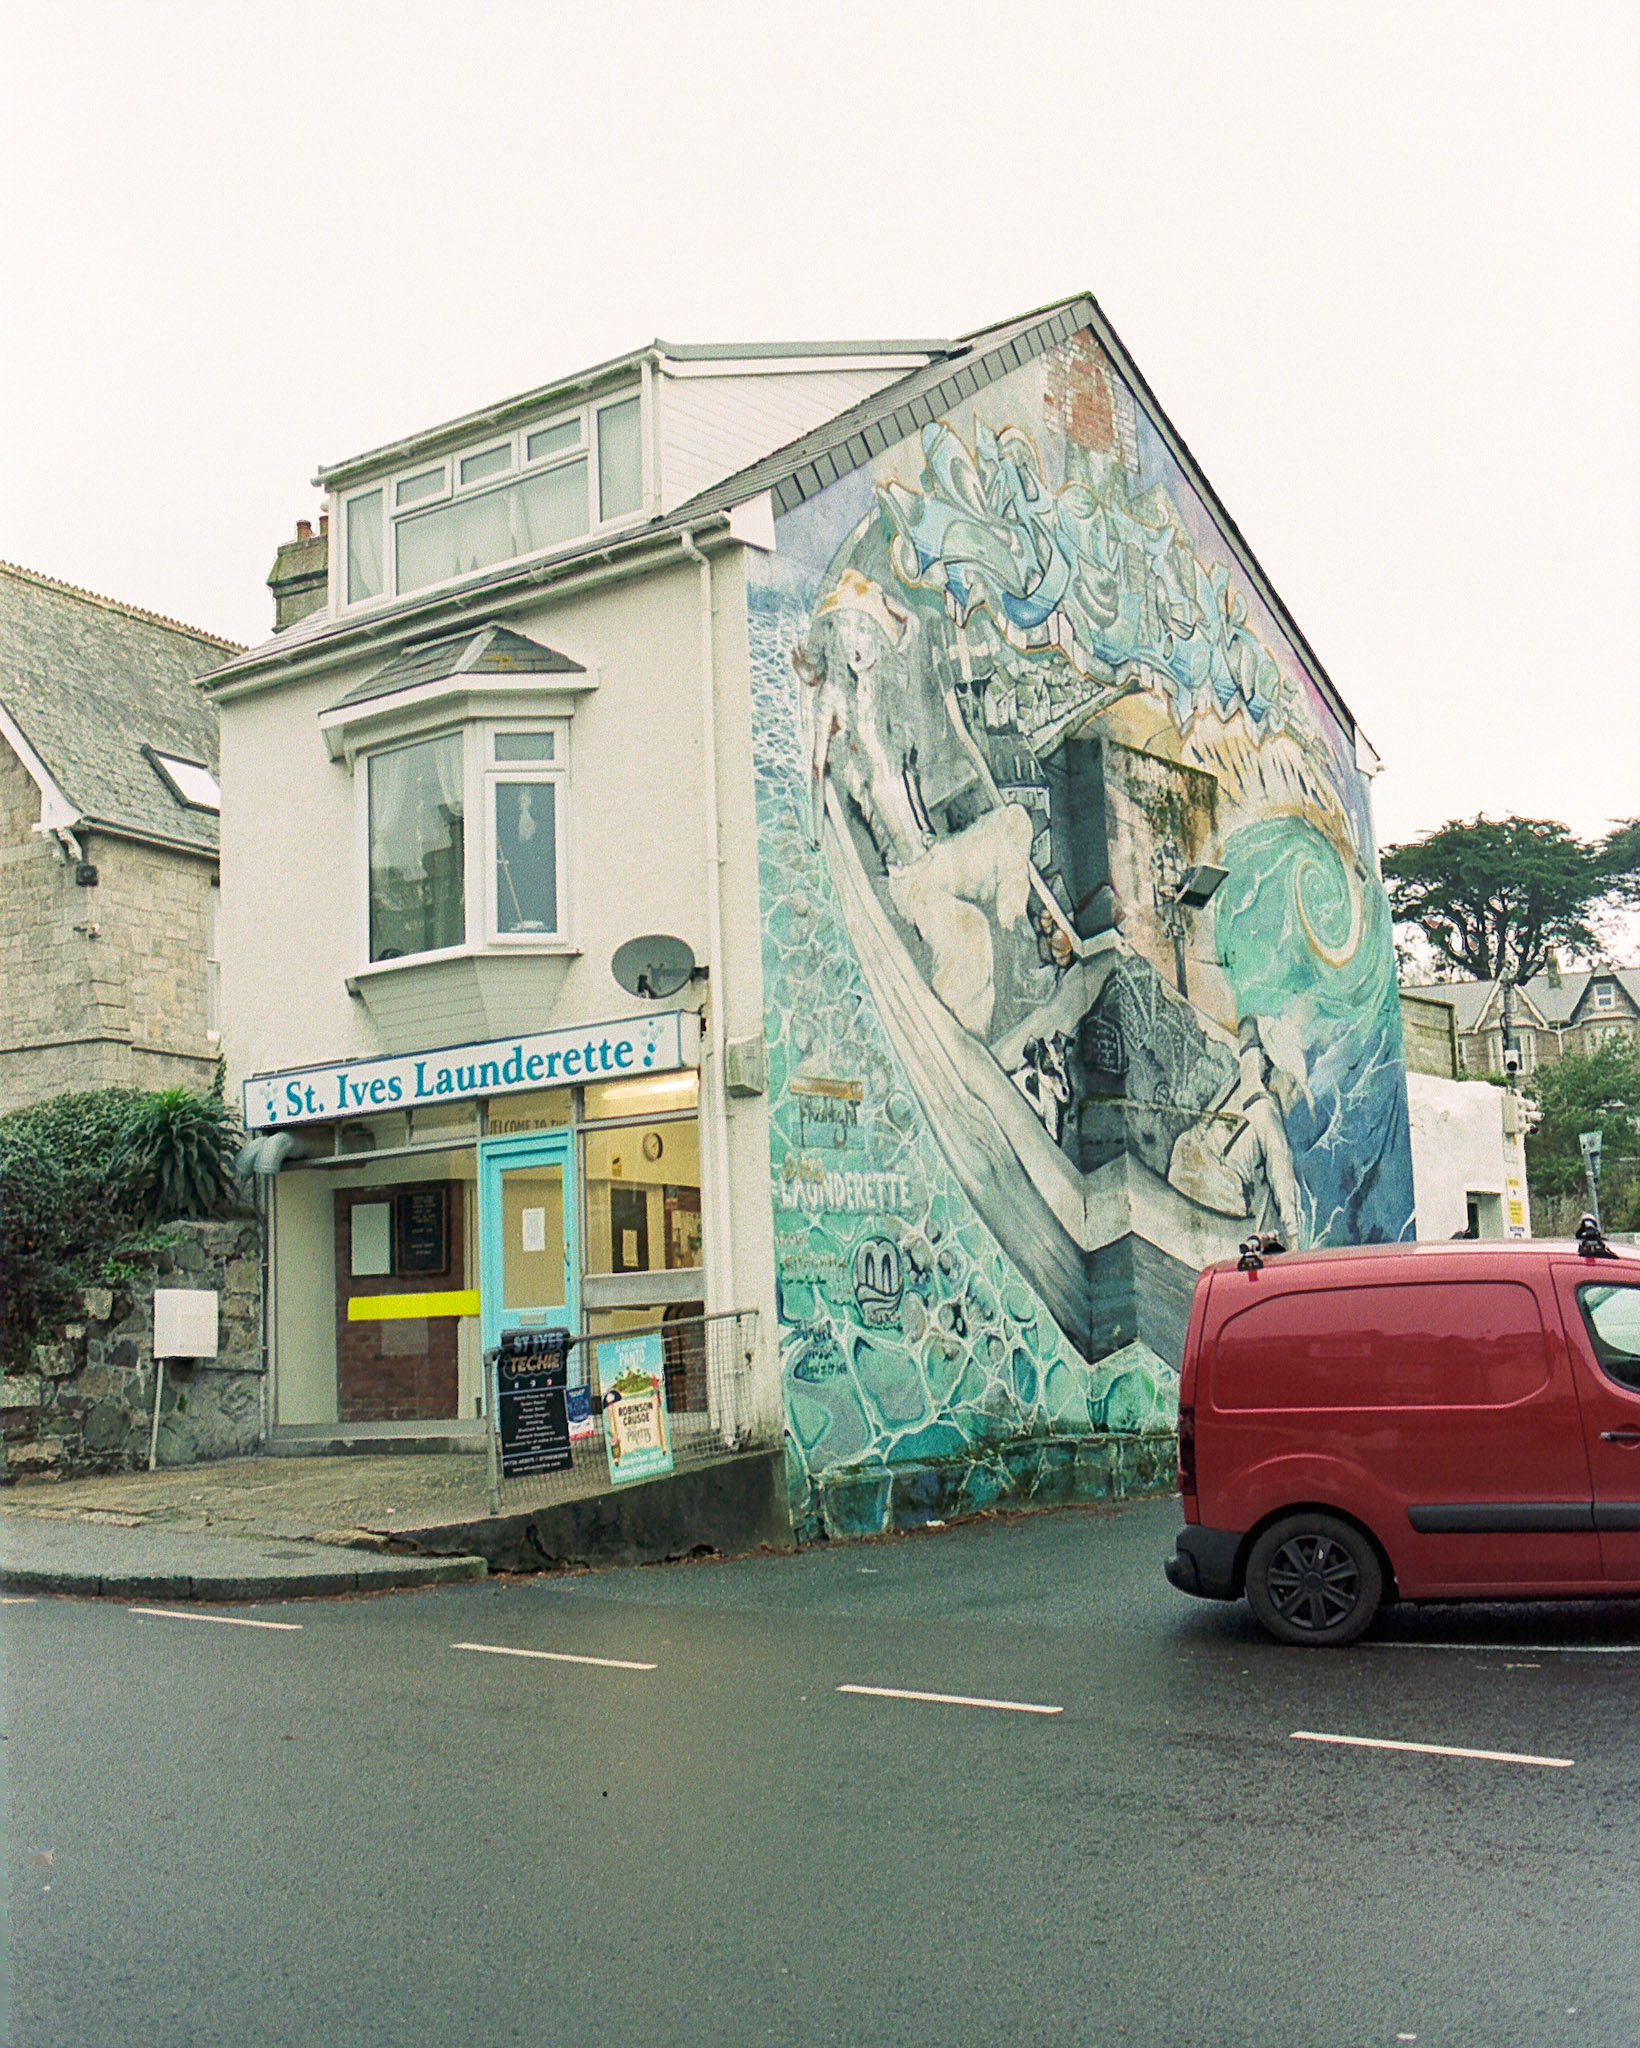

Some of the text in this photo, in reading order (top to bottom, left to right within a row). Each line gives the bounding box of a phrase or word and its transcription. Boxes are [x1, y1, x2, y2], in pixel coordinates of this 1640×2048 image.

[286, 1039, 634, 1117] St. Ives Launderette
[511, 1352, 561, 1373] TECHIE
[618, 1402, 653, 1417] ROBINSON
[622, 1414, 650, 1427] CRUSOE
